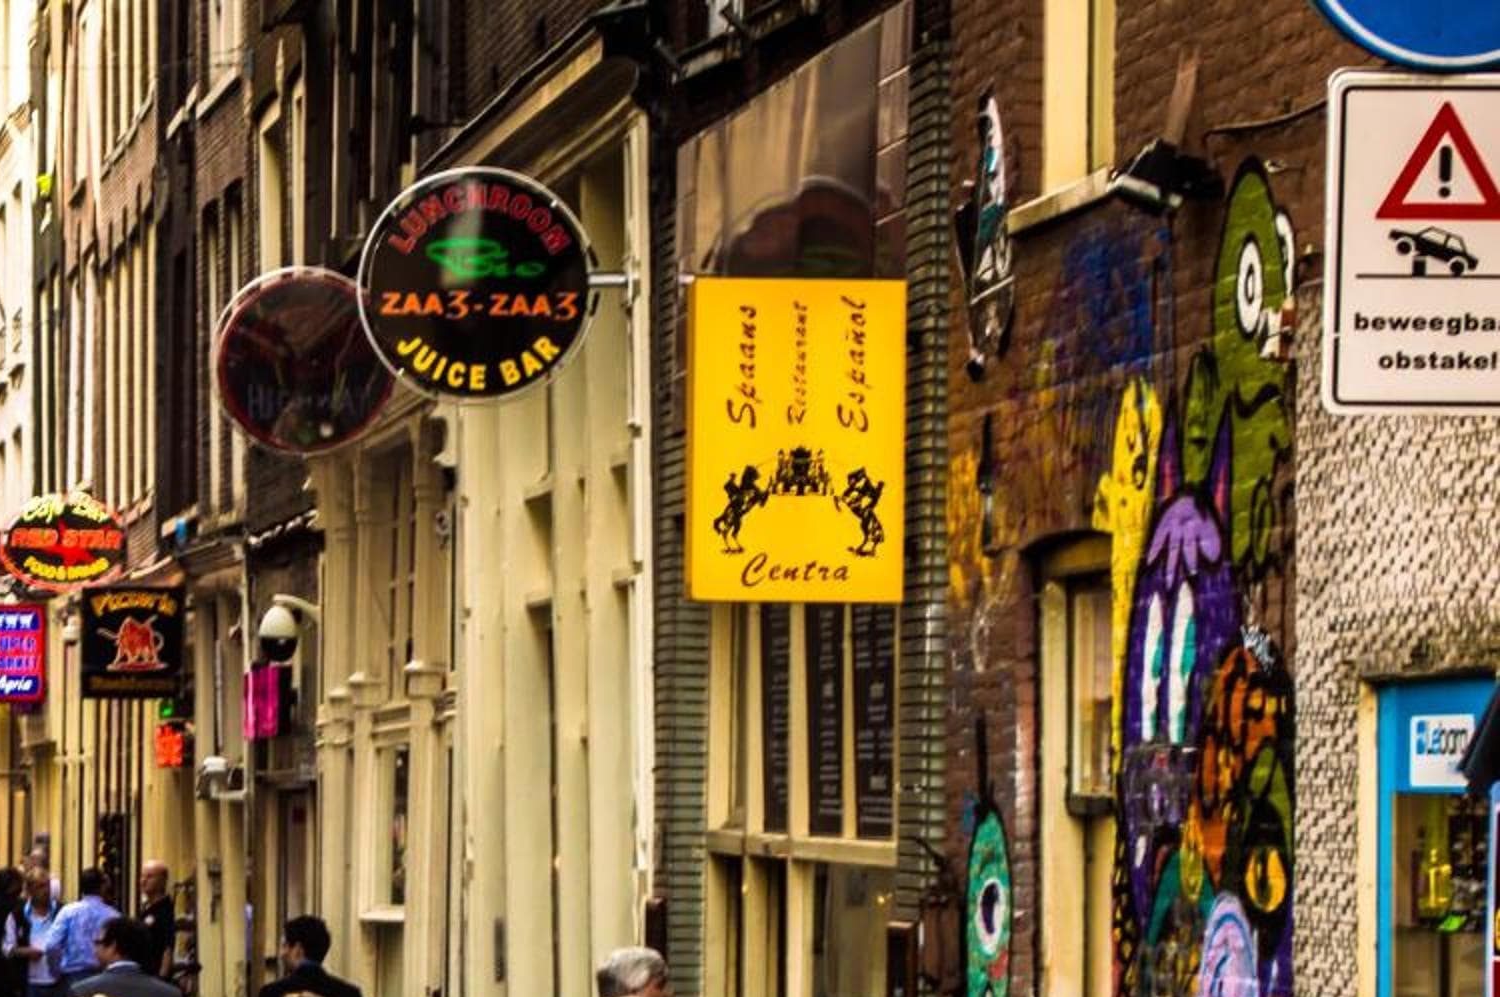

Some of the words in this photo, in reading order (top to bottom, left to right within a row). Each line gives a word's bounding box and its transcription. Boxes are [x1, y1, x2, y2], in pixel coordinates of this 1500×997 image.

[387, 183, 572, 256] LUNCHROOM
[1354, 312, 1500, 336] beweegba
[397, 336, 487, 390] JUICE
[499, 336, 561, 386] BAR
[726, 304, 761, 430] Spaans
[787, 300, 808, 425] Restaurant
[836, 295, 871, 433] Español
[1378, 350, 1498, 370] obstakel
[741, 552, 850, 588] Centra
